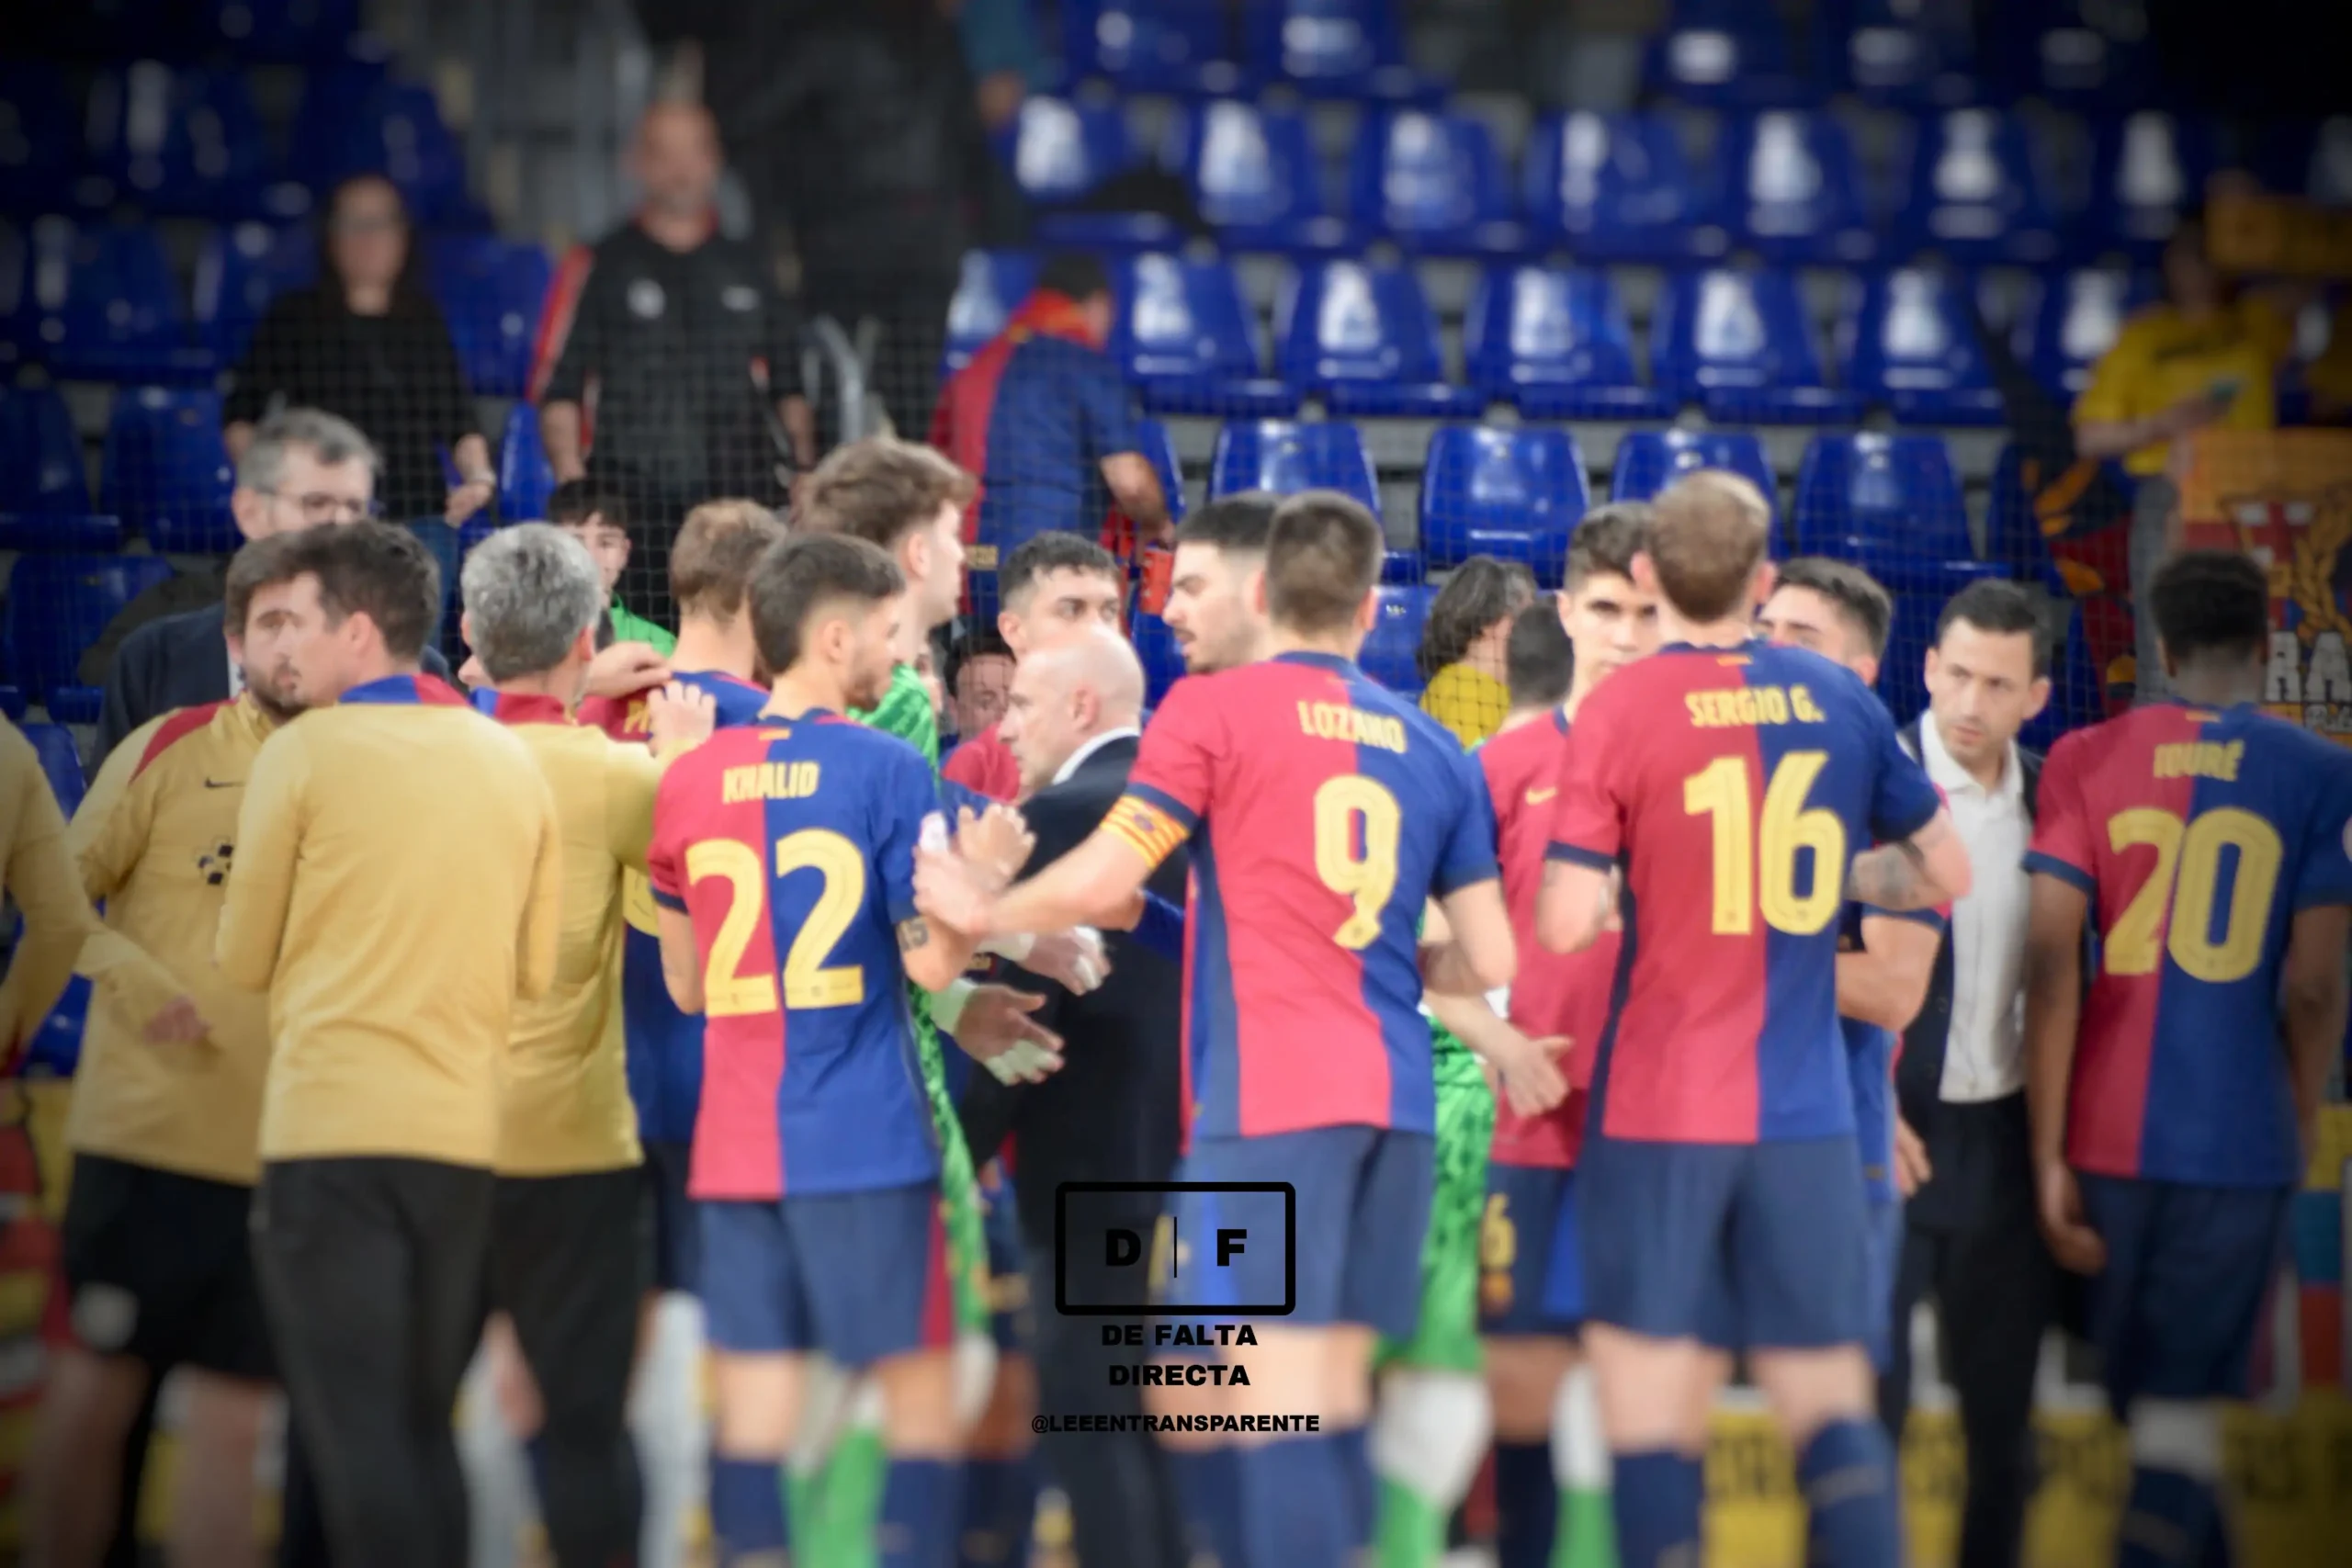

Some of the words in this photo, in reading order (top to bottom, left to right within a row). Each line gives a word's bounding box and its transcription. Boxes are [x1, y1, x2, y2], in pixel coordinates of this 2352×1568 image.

[722, 761, 820, 805] KHALID
[1296, 698, 1408, 753] LOZANO
[1685, 685, 1788, 727] SERGIO
[1790, 685, 1826, 723] G.
[684, 826, 865, 1017] 22
[1314, 774, 1402, 950] 9
[1683, 749, 1847, 936] 16
[2104, 806, 2282, 983] 20
